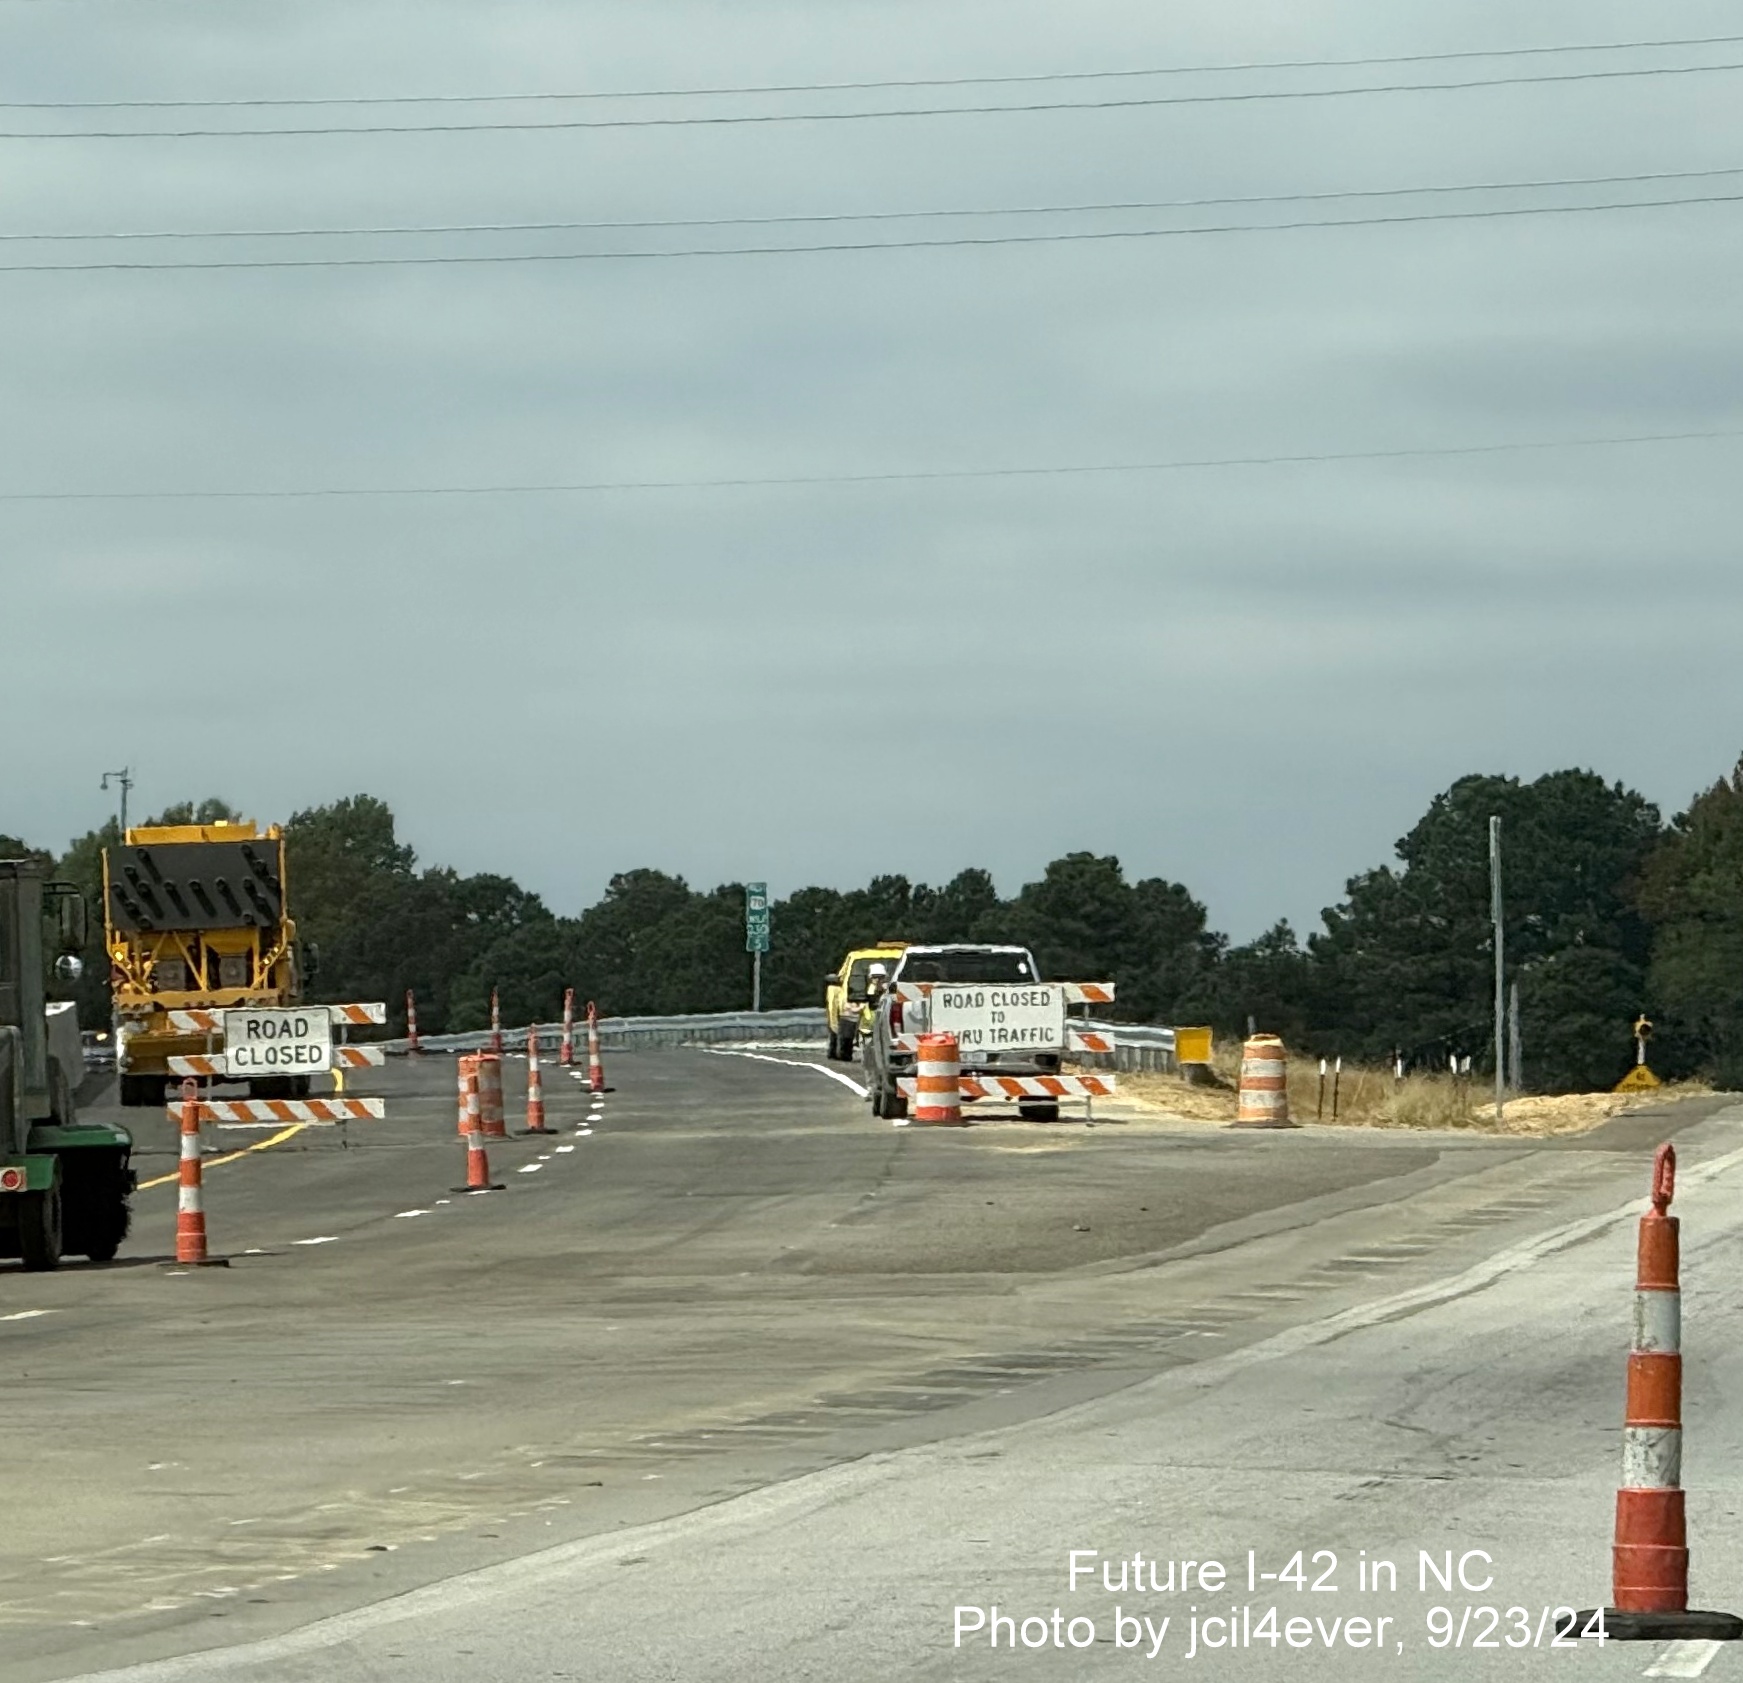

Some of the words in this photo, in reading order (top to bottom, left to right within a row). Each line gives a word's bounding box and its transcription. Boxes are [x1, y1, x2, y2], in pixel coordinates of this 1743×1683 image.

[943, 992, 985, 1008] ROAD
[991, 991, 1050, 1007] CLOSED
[990, 1011, 1005, 1023] TO
[247, 1018, 309, 1039] ROAD
[989, 1027, 1054, 1043] TRAFFIC
[235, 1045, 323, 1066] CLOSED
